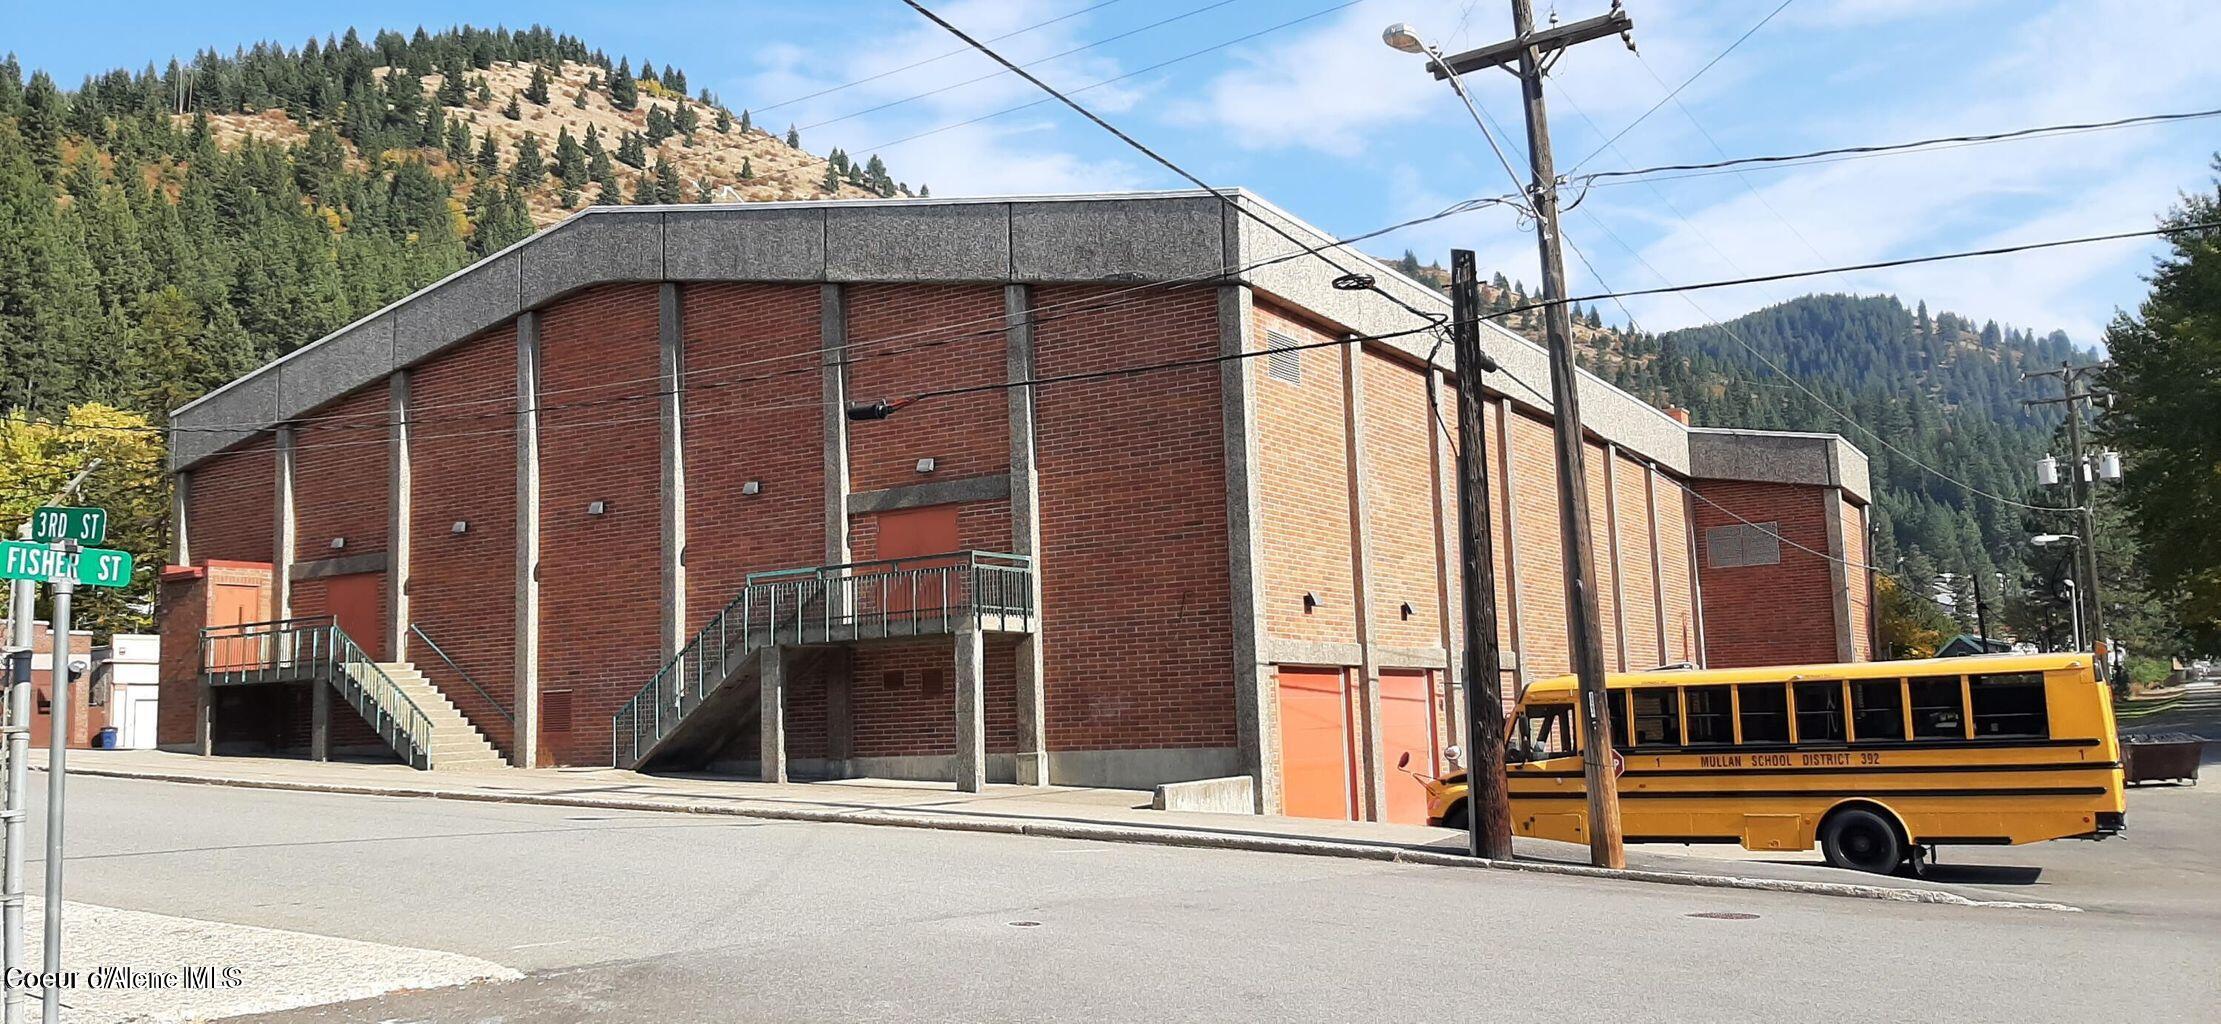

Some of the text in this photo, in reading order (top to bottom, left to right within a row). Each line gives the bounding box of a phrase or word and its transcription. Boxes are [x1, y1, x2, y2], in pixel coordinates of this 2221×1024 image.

[37, 511, 100, 539] 3RD ST
[6, 546, 122, 581] FISHER ST
[1700, 752, 1880, 768] MULLAN SCHOOL DISTRICT 392
